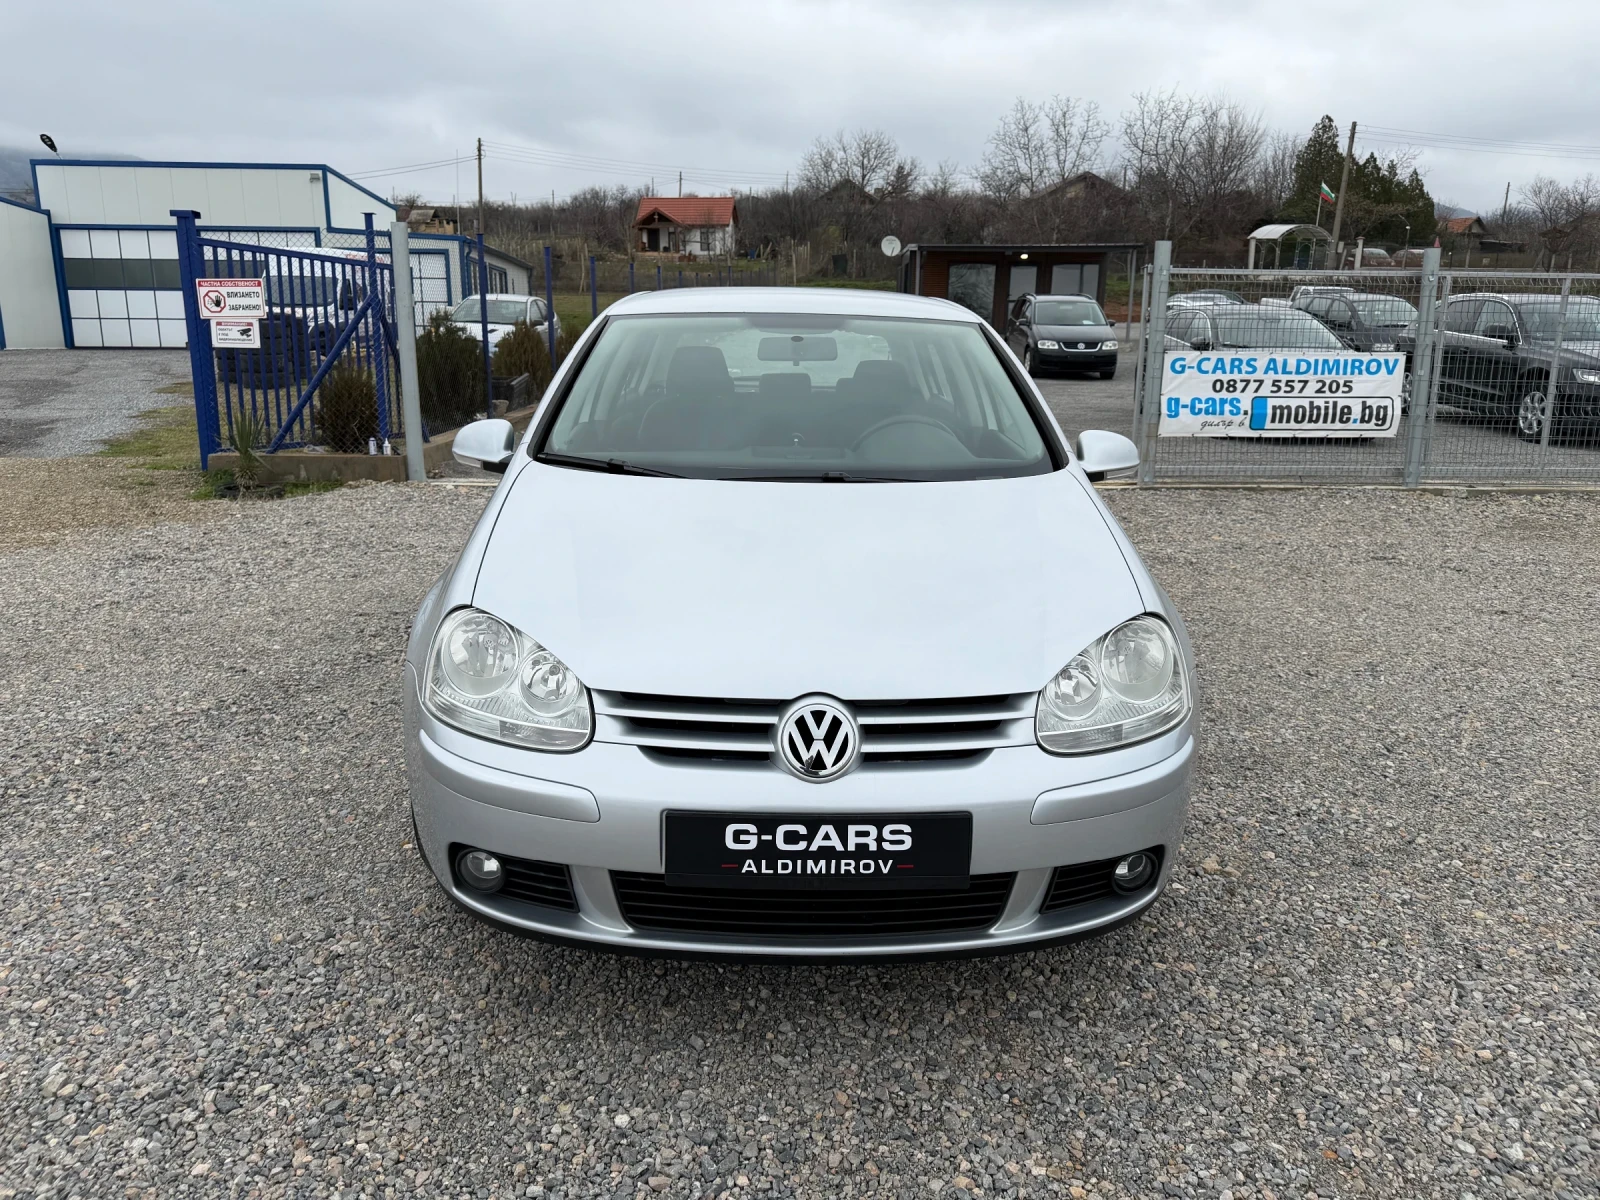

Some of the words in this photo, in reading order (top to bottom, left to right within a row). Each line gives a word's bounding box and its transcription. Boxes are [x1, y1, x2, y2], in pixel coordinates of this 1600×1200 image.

[1170, 357, 1258, 375] G-CARS
[1263, 358, 1400, 376] ALDIMIROV
[1212, 379, 1265, 394] 0877
[1270, 379, 1309, 394] 557
[1314, 380, 1354, 394] 205
[1270, 401, 1389, 427] mobile.bg
[724, 823, 913, 852] G-CARS
[741, 859, 894, 875] ALDIMIROV
